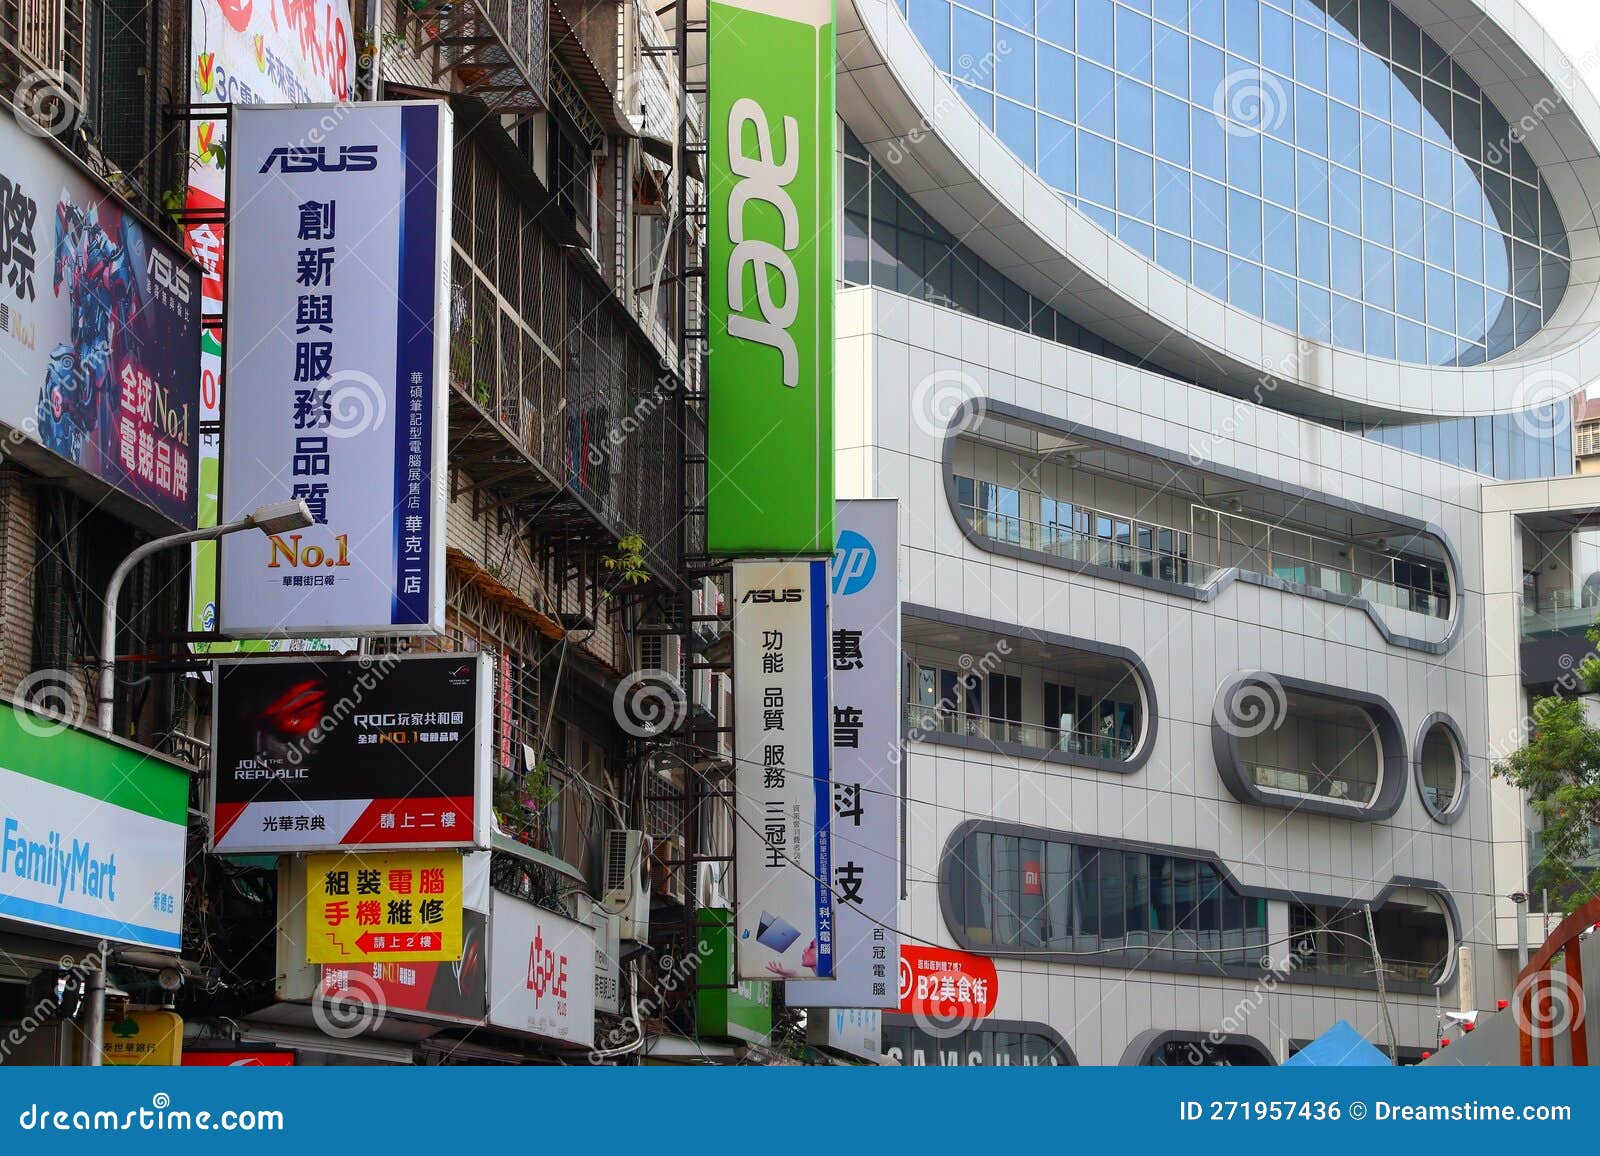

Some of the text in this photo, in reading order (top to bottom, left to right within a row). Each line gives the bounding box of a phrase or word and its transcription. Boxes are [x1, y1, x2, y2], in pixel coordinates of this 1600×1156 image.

[260, 144, 378, 174] ASUS
[727, 97, 799, 388] acer
[147, 246, 191, 305] ASUS
[291, 199, 337, 525] 創新與服務品質
[120, 416, 189, 502] 電競品牌
[267, 534, 351, 568] No.1
[404, 515, 423, 594] 華克二店
[282, 575, 335, 587] 華爾街日報
[742, 589, 803, 604] ASUS
[234, 756, 268, 769] JOIN
[762, 629, 786, 868] 功能 品質 服務 三冠王
[234, 768, 309, 780] REPUBLIC
[263, 811, 456, 832] 光華京典 請上二樓
[1, 817, 117, 904] FamilyMart
[325, 868, 445, 896] 組裝電腦
[324, 898, 445, 927] 手機維修
[373, 935, 432, 950] 請上2樓
[872, 927, 886, 997] 百冠電腦
[917, 975, 988, 1005] B2美食街
